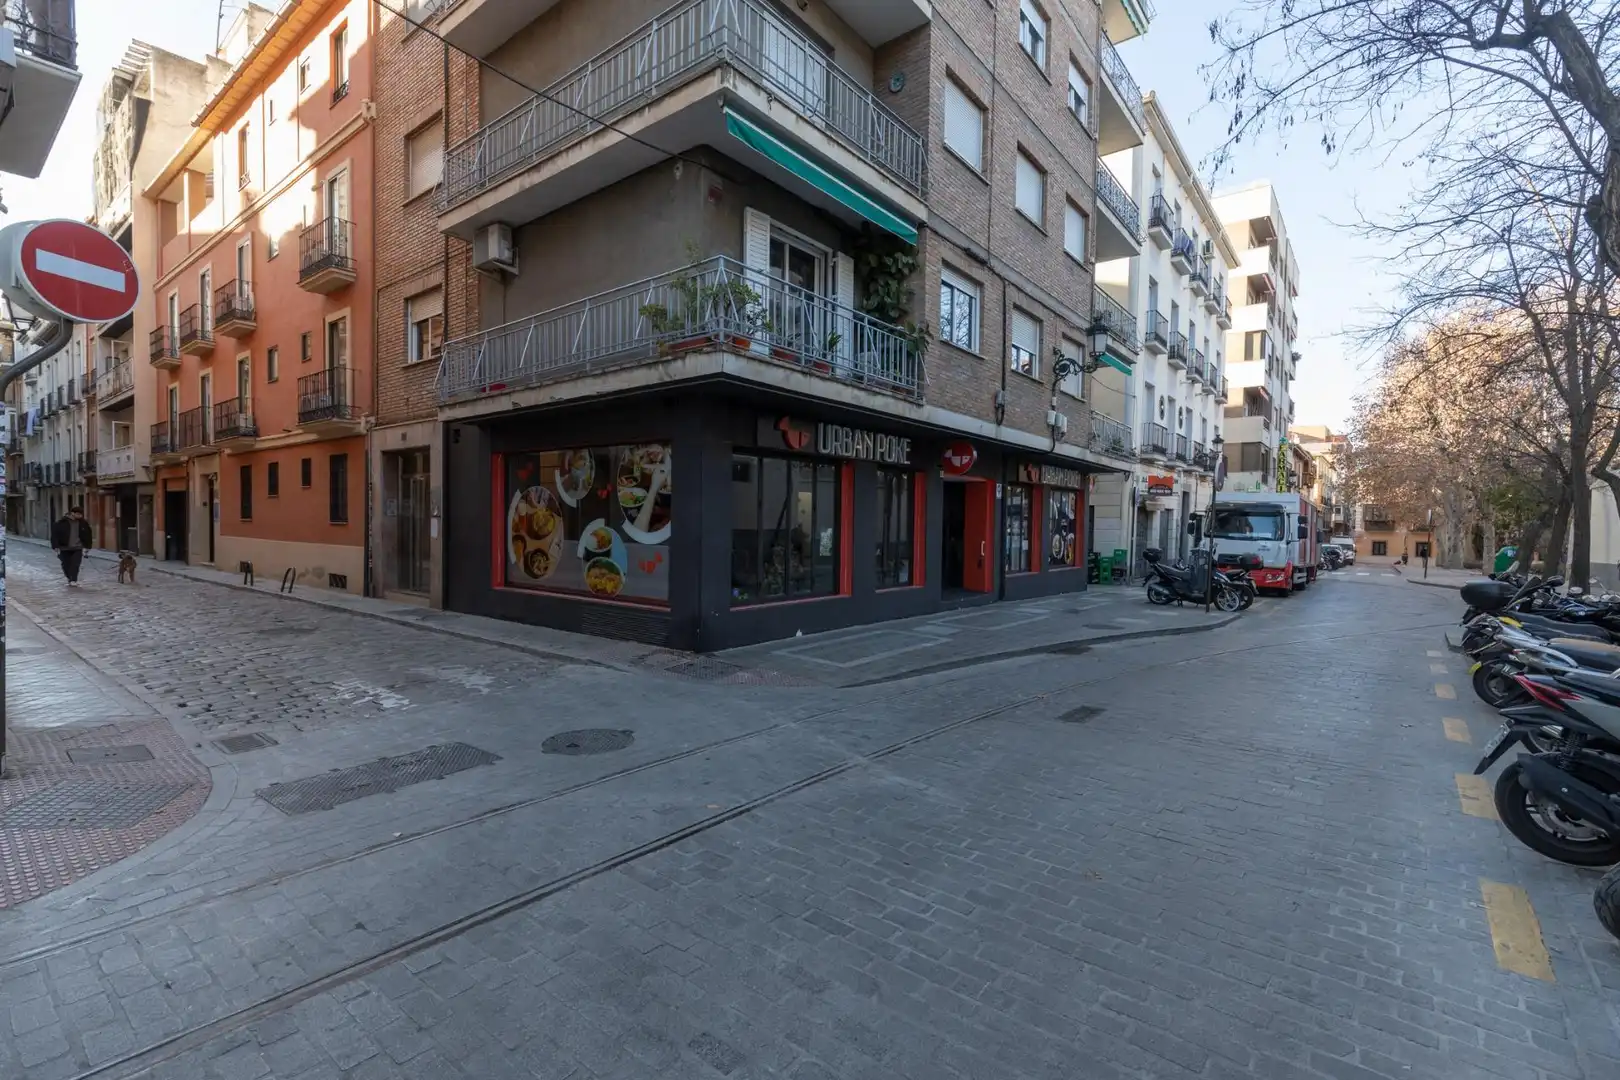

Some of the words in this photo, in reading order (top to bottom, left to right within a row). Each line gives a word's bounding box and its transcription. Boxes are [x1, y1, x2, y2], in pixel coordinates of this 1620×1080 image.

[817, 421, 874, 460] URBAN
[874, 433, 911, 465] POKE
[1277, 444, 1288, 491] FARMACI
